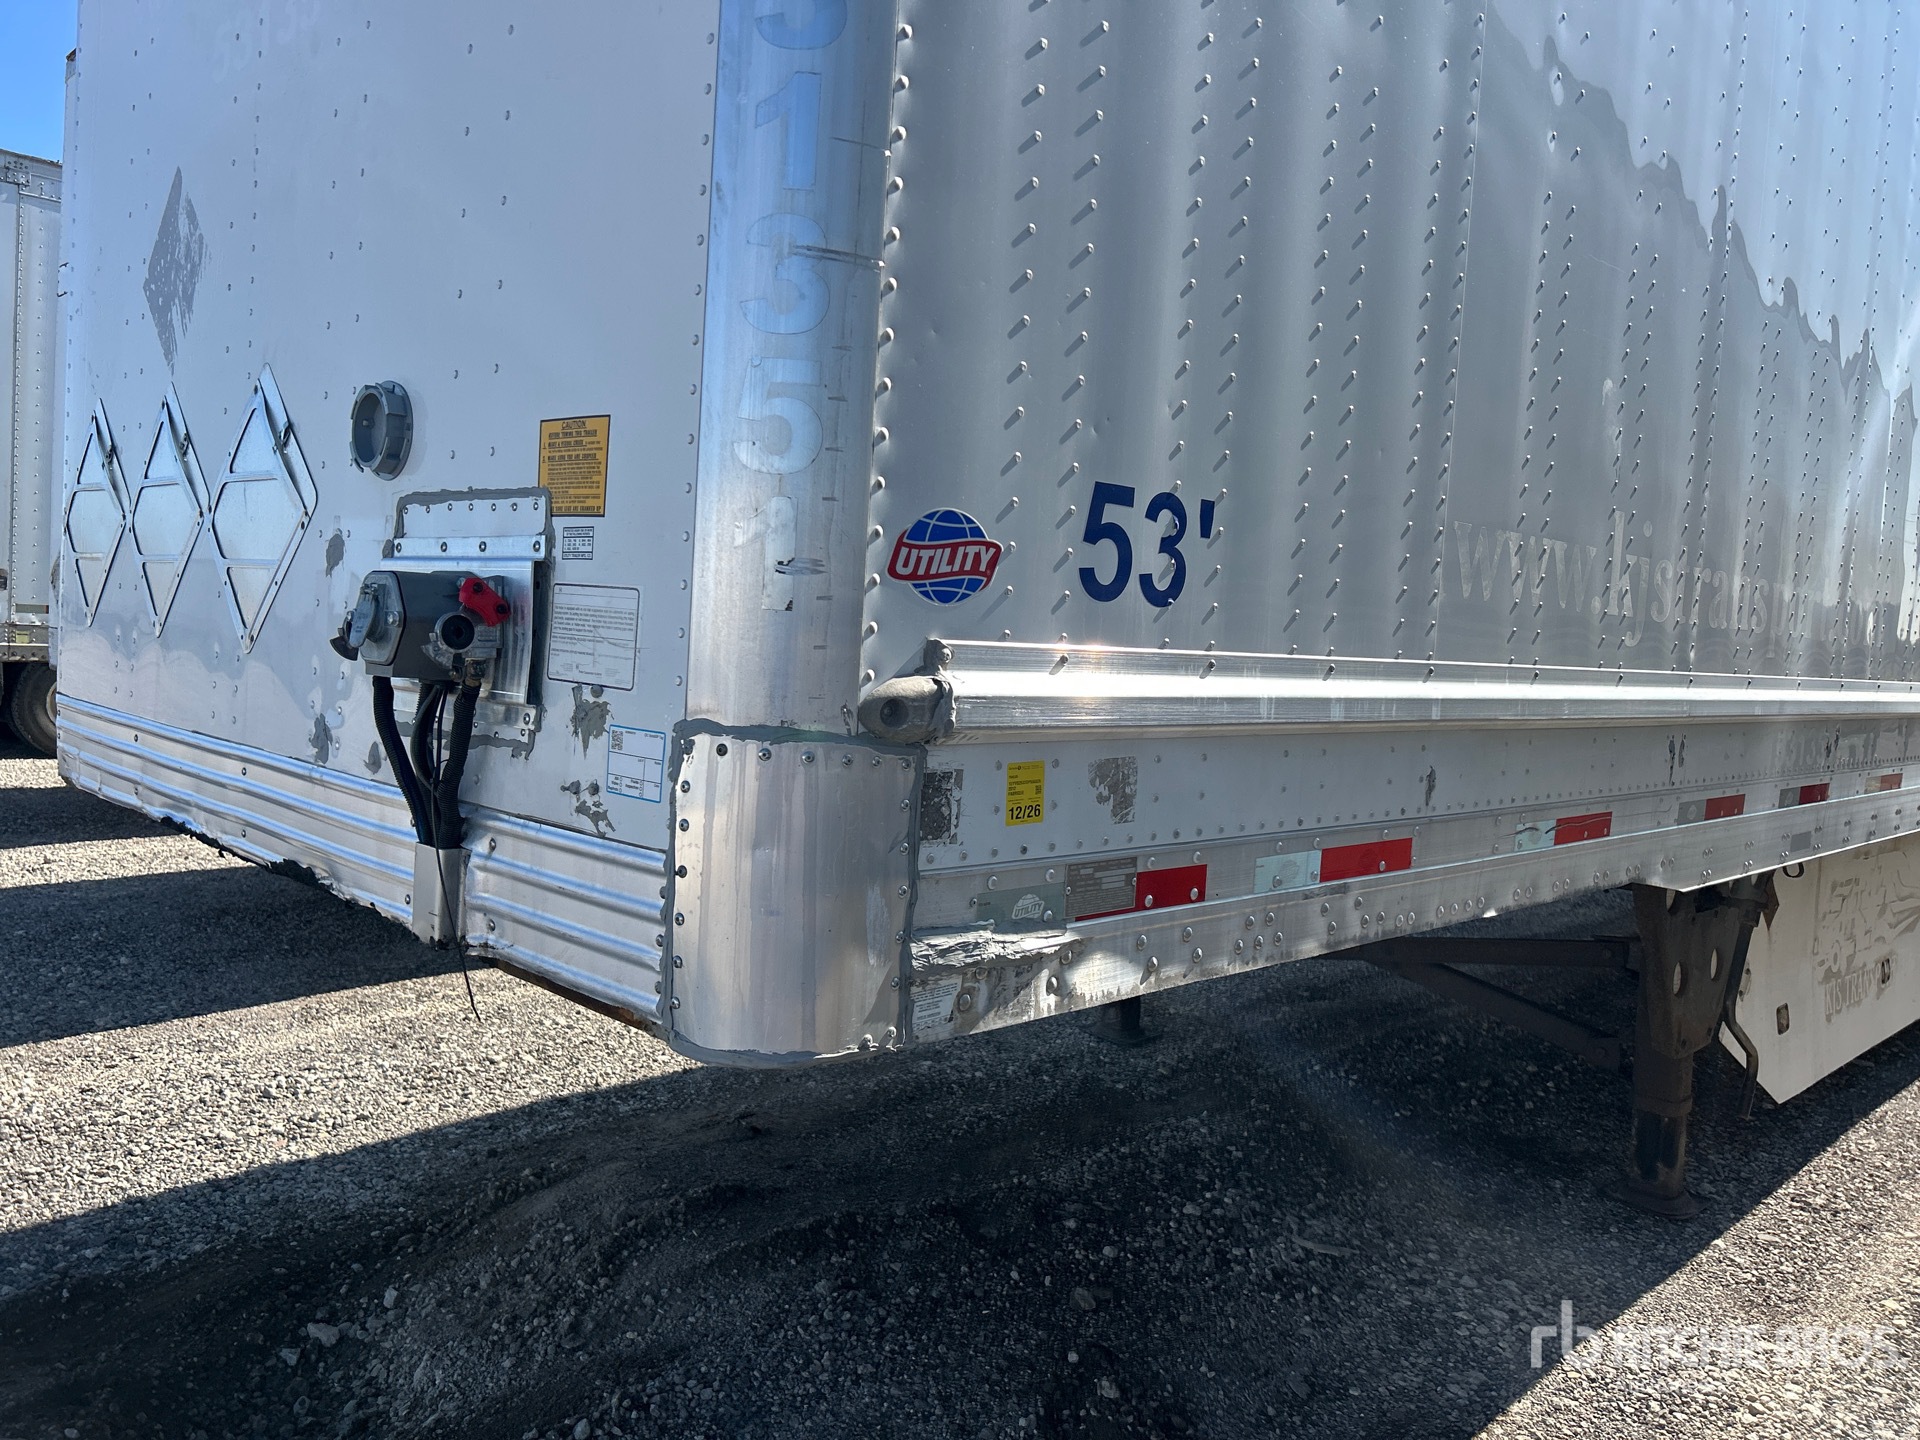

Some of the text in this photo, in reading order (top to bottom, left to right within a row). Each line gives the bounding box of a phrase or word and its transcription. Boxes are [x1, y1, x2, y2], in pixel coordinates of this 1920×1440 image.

[561, 419, 587, 429] CAUTION
[894, 543, 998, 577] UTILITY
[1008, 803, 1041, 821] 12/26
[1014, 902, 1043, 918] UTILITY
[1845, 954, 1897, 1006] TRANSP
